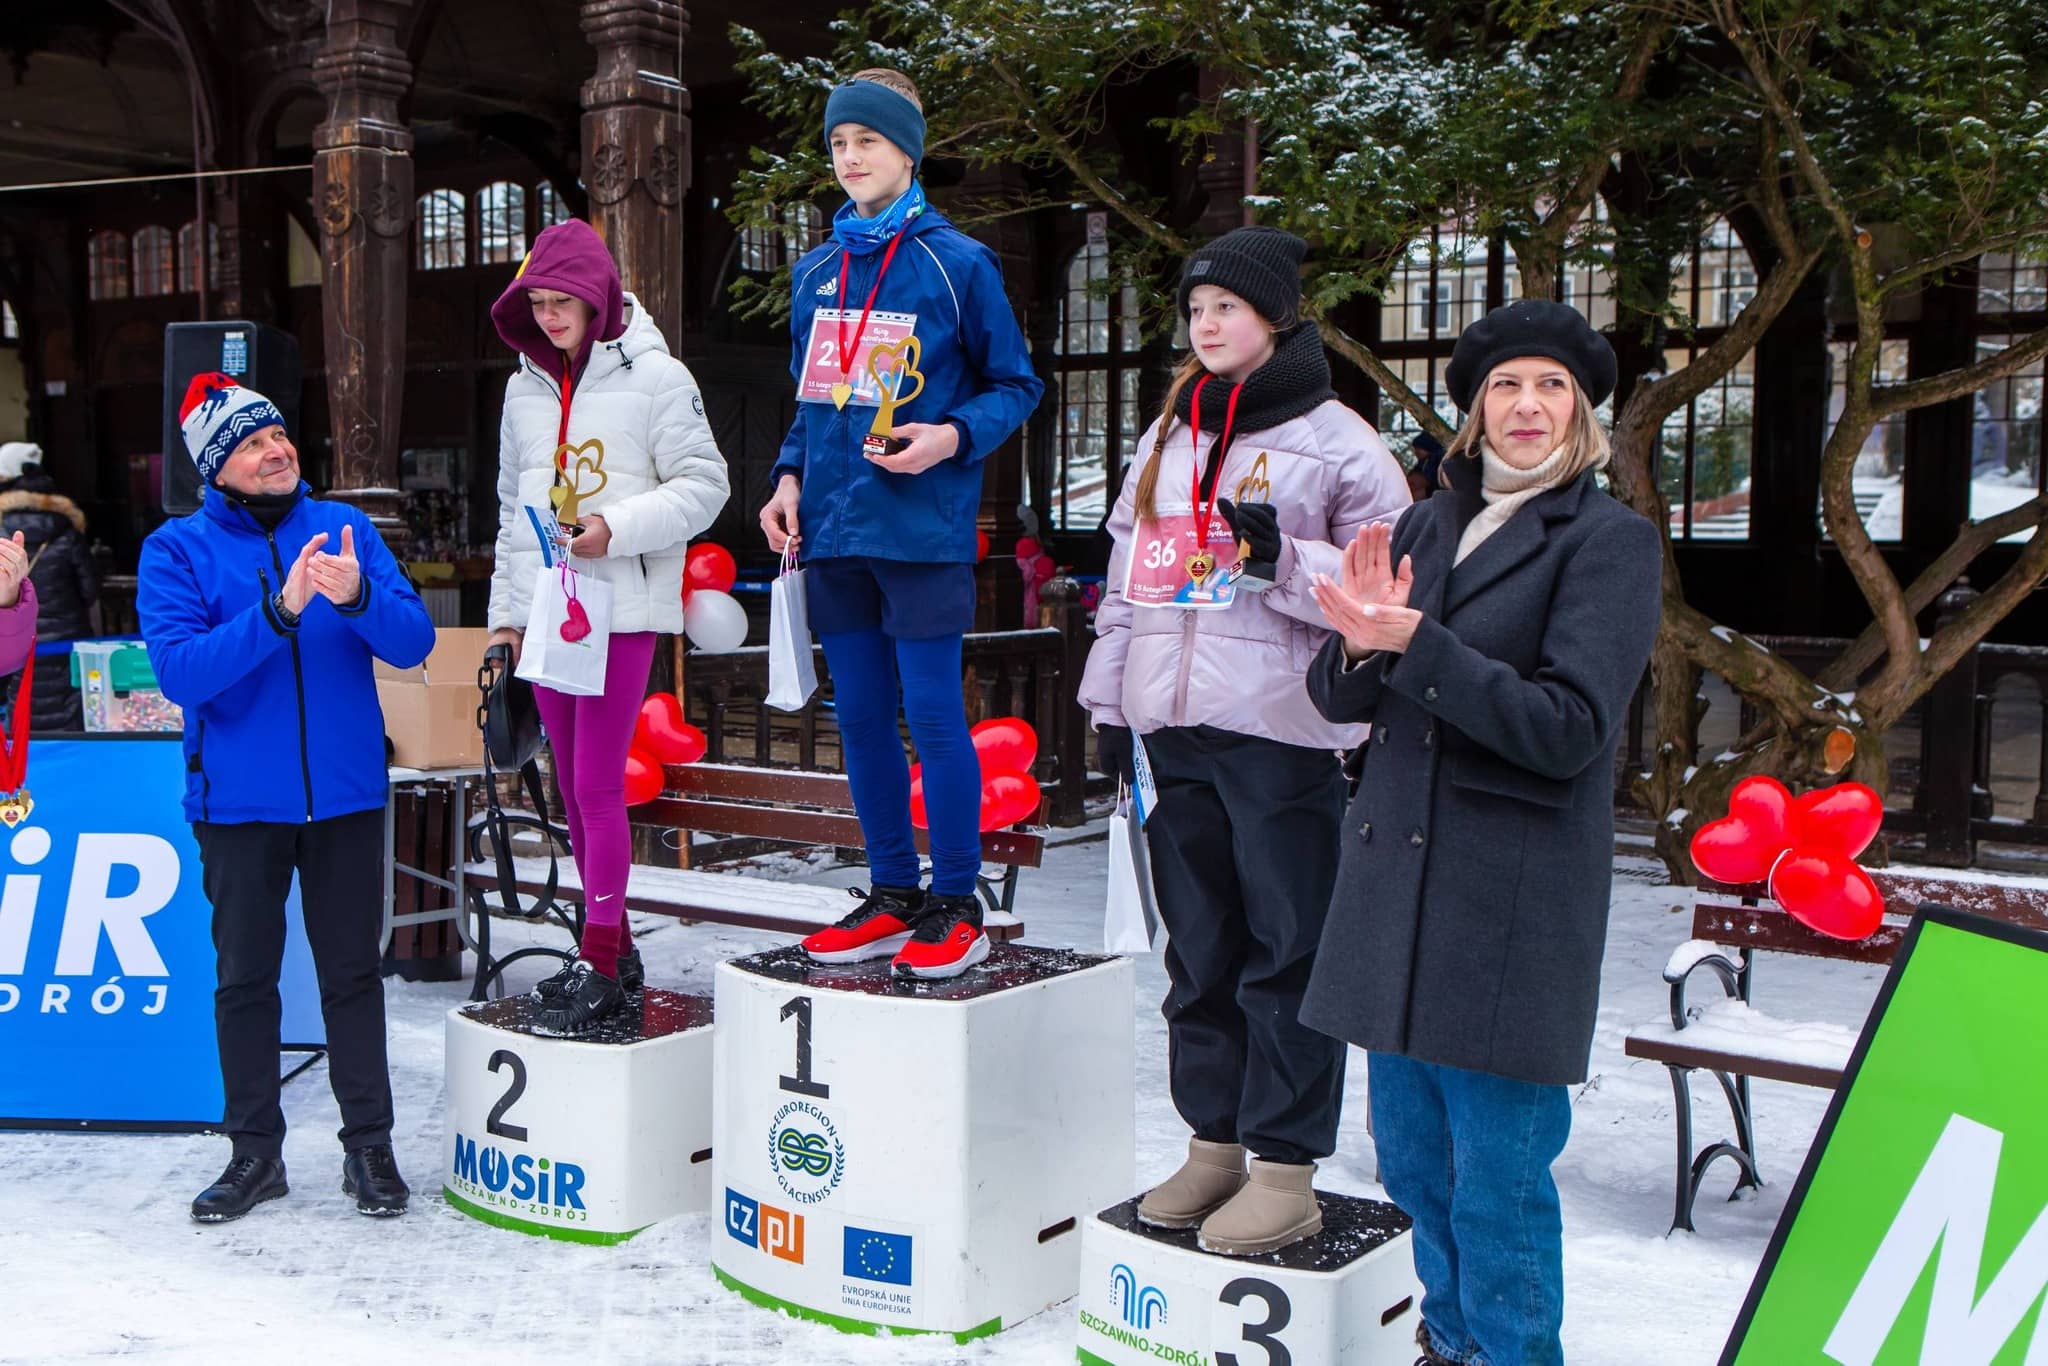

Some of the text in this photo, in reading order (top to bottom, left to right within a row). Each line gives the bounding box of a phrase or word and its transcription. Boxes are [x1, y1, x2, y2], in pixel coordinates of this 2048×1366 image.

[1143, 537, 1177, 569] 36
[779, 996, 830, 1100] 1
[487, 1049, 528, 1142] 2
[774, 1101, 837, 1137] EUROREGION
[454, 1132, 586, 1210] MOSiR
[778, 1175, 831, 1204] GLACENSIS
[453, 1175, 587, 1222] SZCZAWNO-ZDRÓJ
[842, 1283, 912, 1305] EVROPSKÁ UNIE
[842, 1296, 912, 1315] UNIA EUROPEJSKA
[1215, 1277, 1292, 1366] 3
